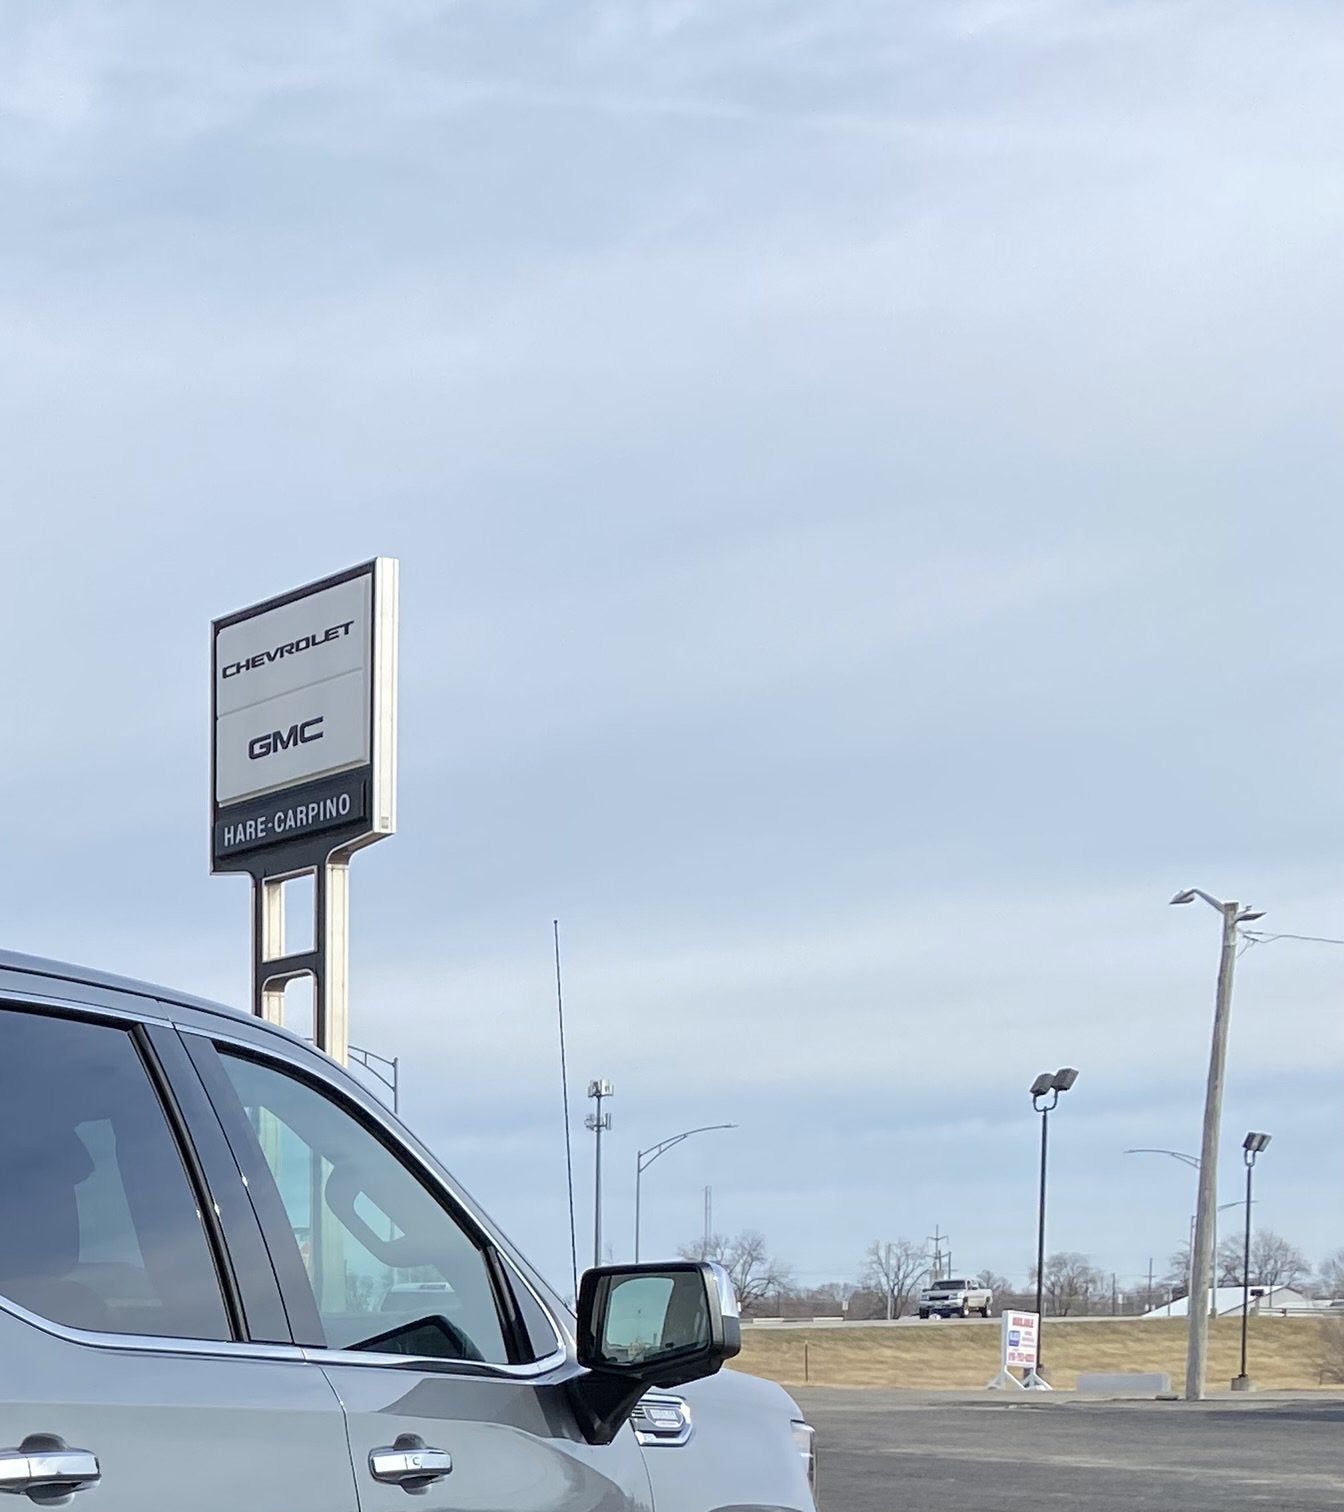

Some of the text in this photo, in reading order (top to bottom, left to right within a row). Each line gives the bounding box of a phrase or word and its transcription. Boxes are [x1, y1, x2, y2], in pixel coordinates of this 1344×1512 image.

[222, 620, 355, 680] CHEVROLET
[248, 716, 324, 760] GMC
[223, 793, 351, 848] HARE-CARPINO
